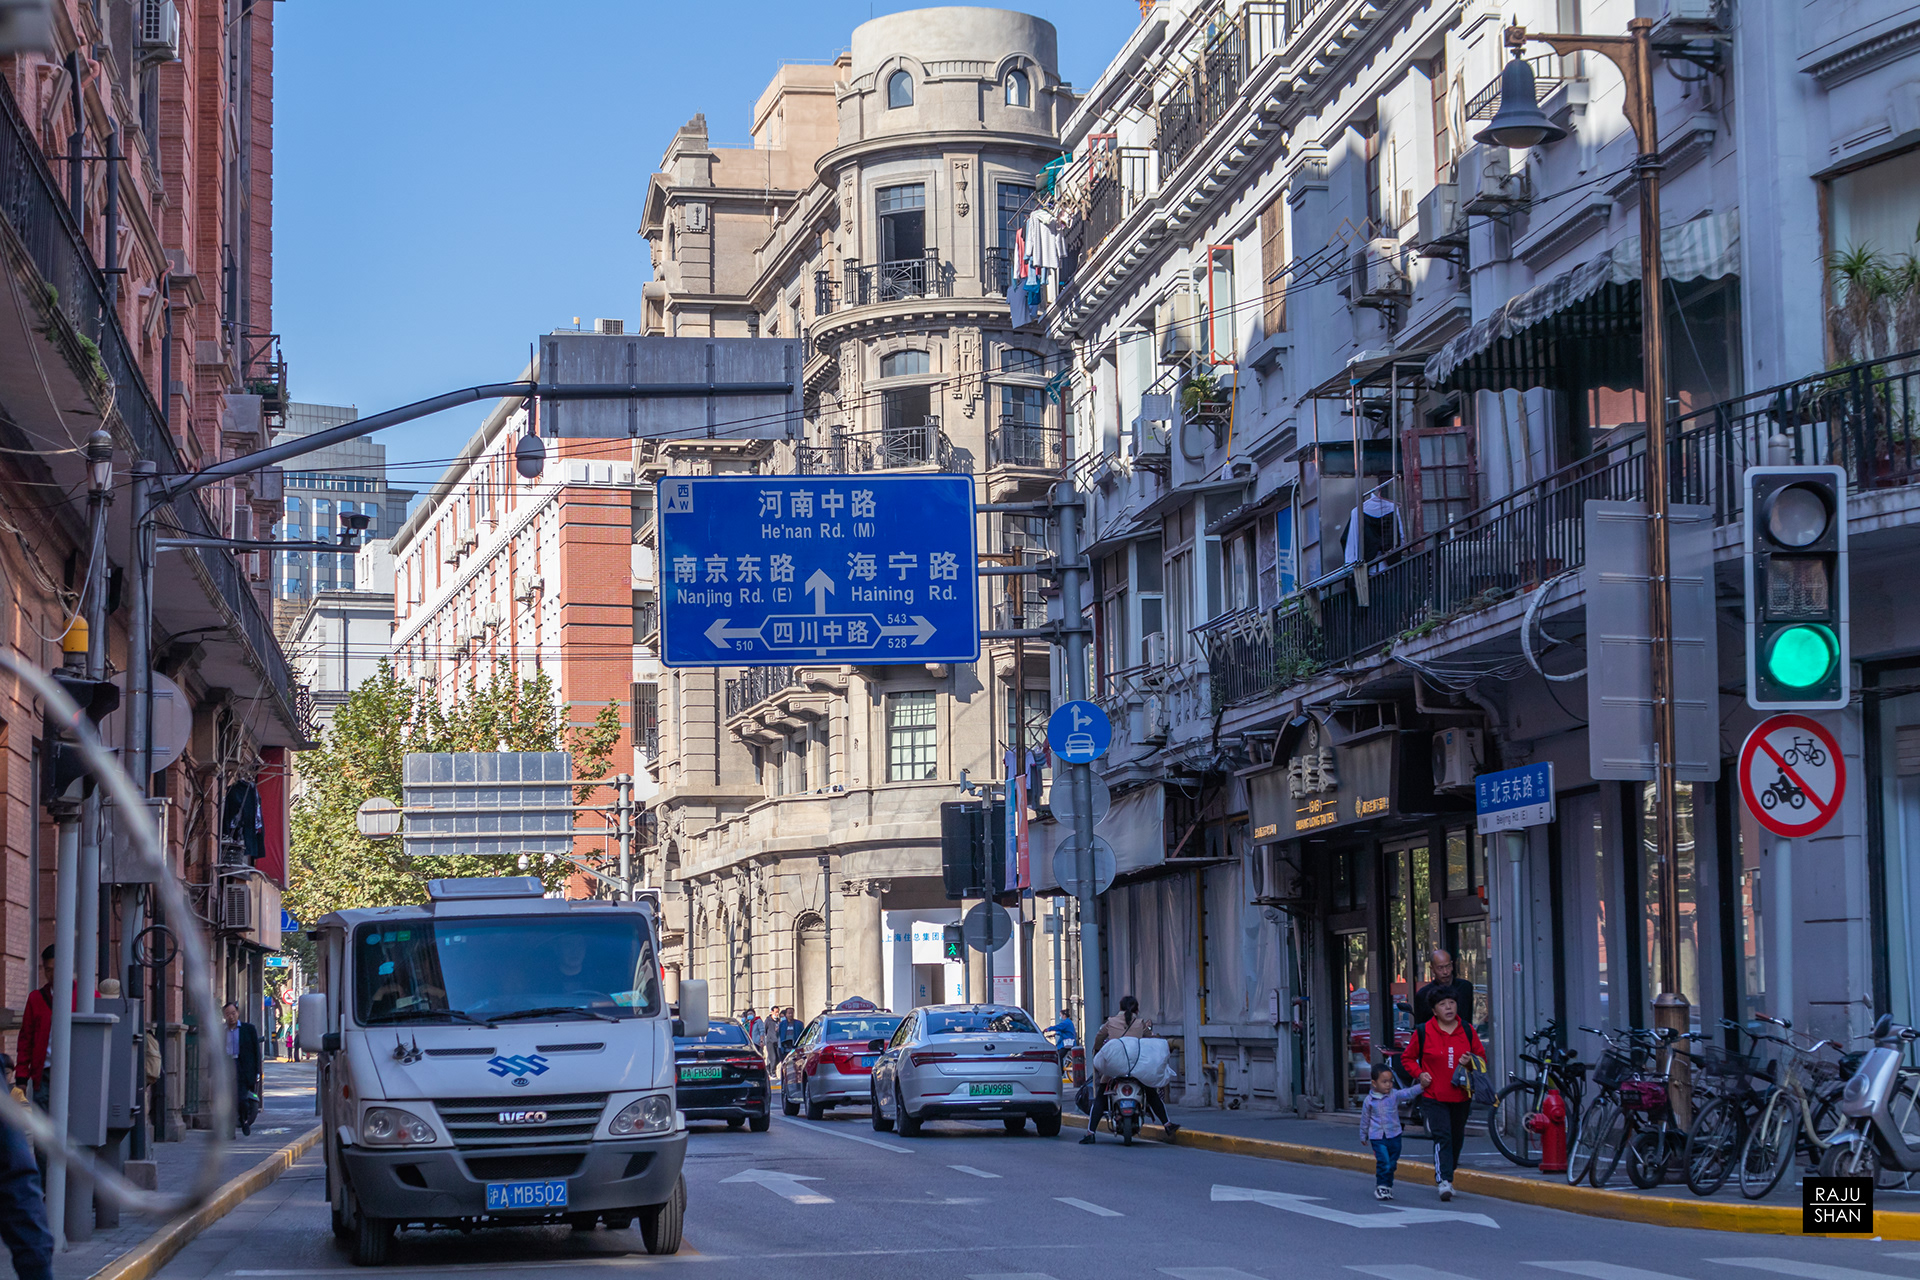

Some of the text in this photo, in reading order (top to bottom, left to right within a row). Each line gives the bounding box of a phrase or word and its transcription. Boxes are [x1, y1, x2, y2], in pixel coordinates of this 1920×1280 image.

[677, 484, 689, 498] 西
[679, 500, 689, 510] W
[758, 488, 877, 519] 河南中路
[761, 522, 876, 539] He'nan Rd. (M)
[672, 553, 796, 584] 南京东路
[847, 551, 960, 582] 海宁路
[677, 587, 793, 608] Nanjing Rd. (E)
[851, 585, 958, 605] Haining Rd.
[887, 613, 907, 624] 543
[773, 620, 870, 645] 四川中路
[736, 640, 753, 651] 510
[887, 638, 907, 649] 528
[1491, 774, 1533, 804] 北京东路
[498, 1111, 548, 1125] IVECO
